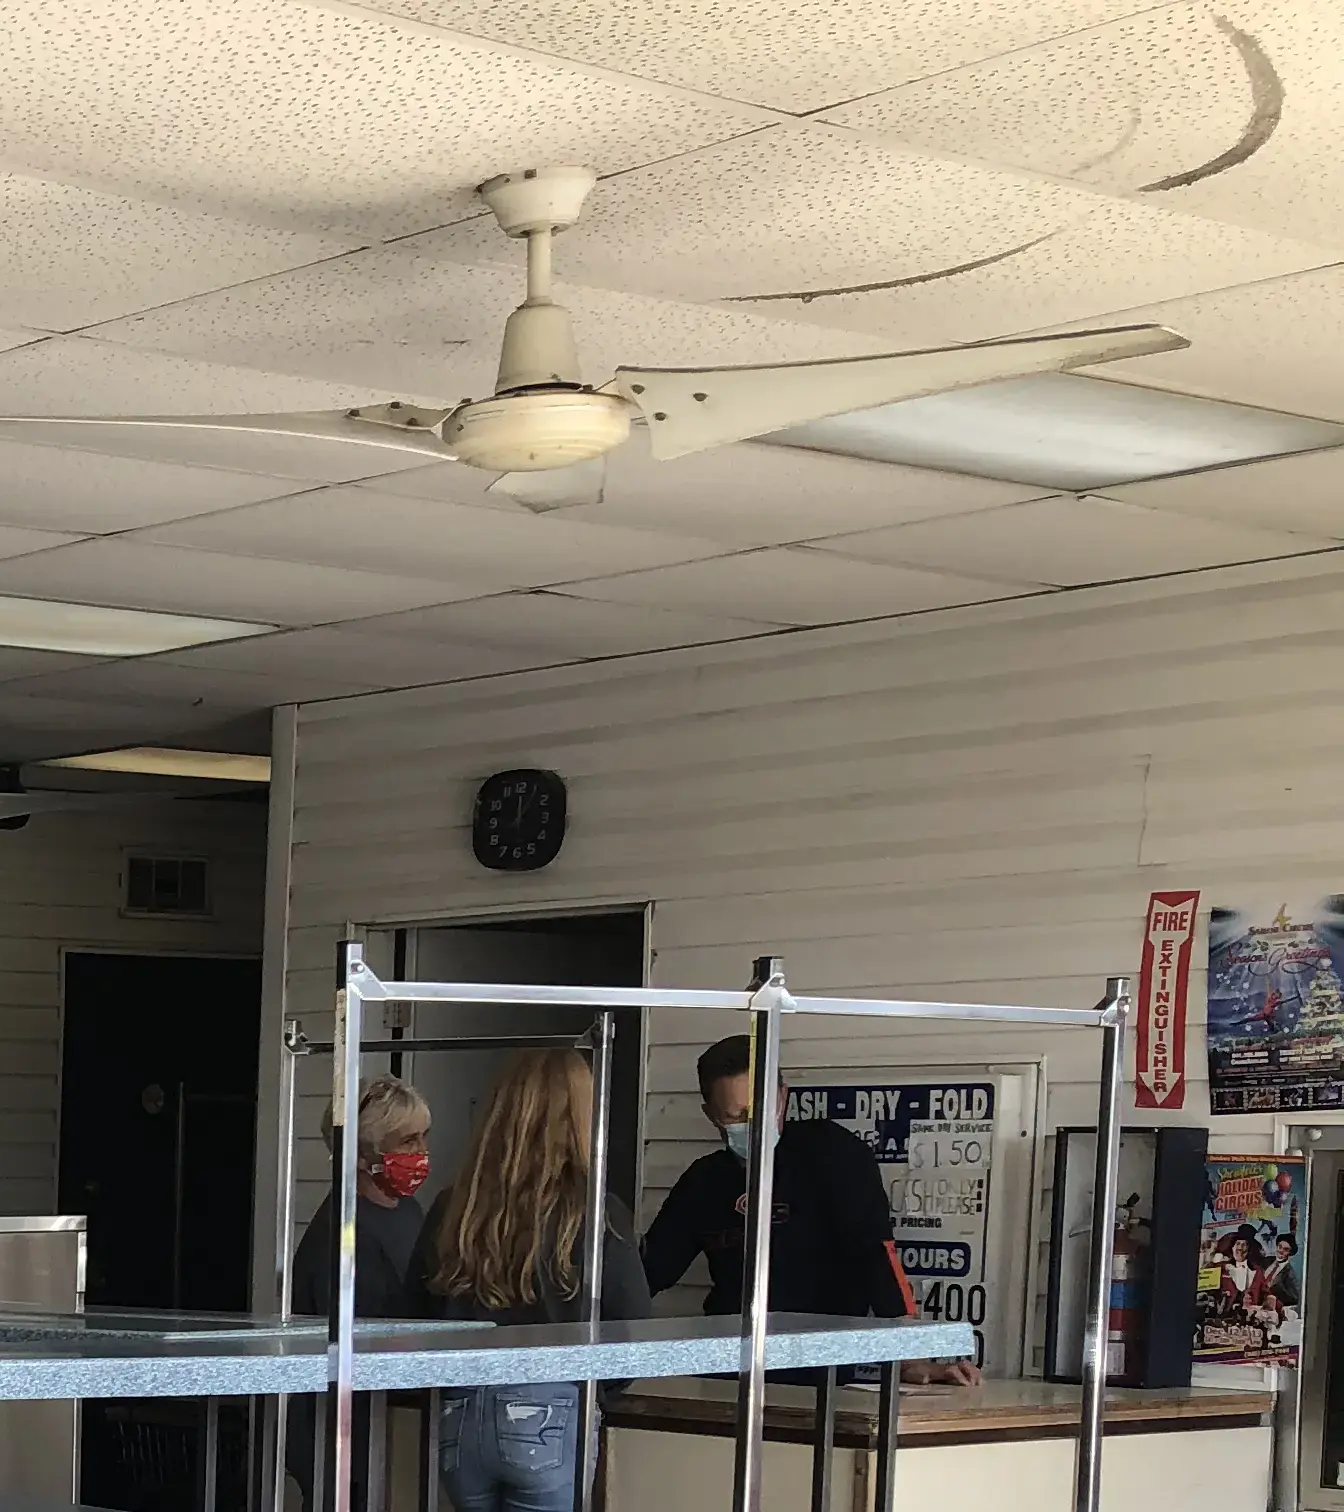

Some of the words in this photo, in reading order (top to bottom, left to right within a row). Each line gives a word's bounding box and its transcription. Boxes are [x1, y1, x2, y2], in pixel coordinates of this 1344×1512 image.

[504, 786, 512, 797] 11
[516, 782, 528, 793] 12
[491, 800, 502, 811] 10
[541, 795, 549, 806] 2
[490, 818, 498, 829] 9
[542, 813, 550, 823] 3
[490, 835, 499, 845] 8
[537, 830, 546, 840] 4
[500, 846, 508, 859] 7
[513, 848, 522, 859] 6
[527, 843, 535, 855] 5
[1152, 911, 1189, 931] FIRE
[1153, 939, 1174, 1093] EXTINGUISHER
[786, 1092, 828, 1121] ASH
[855, 1090, 901, 1121] DRY
[929, 1089, 988, 1120] FOLD
[955, 1123, 992, 1133] SERVICE
[1217, 1177, 1263, 1197] HOLIDAY
[1216, 1192, 1262, 1210] CIRCUS
[901, 1217, 942, 1228] PRICING
